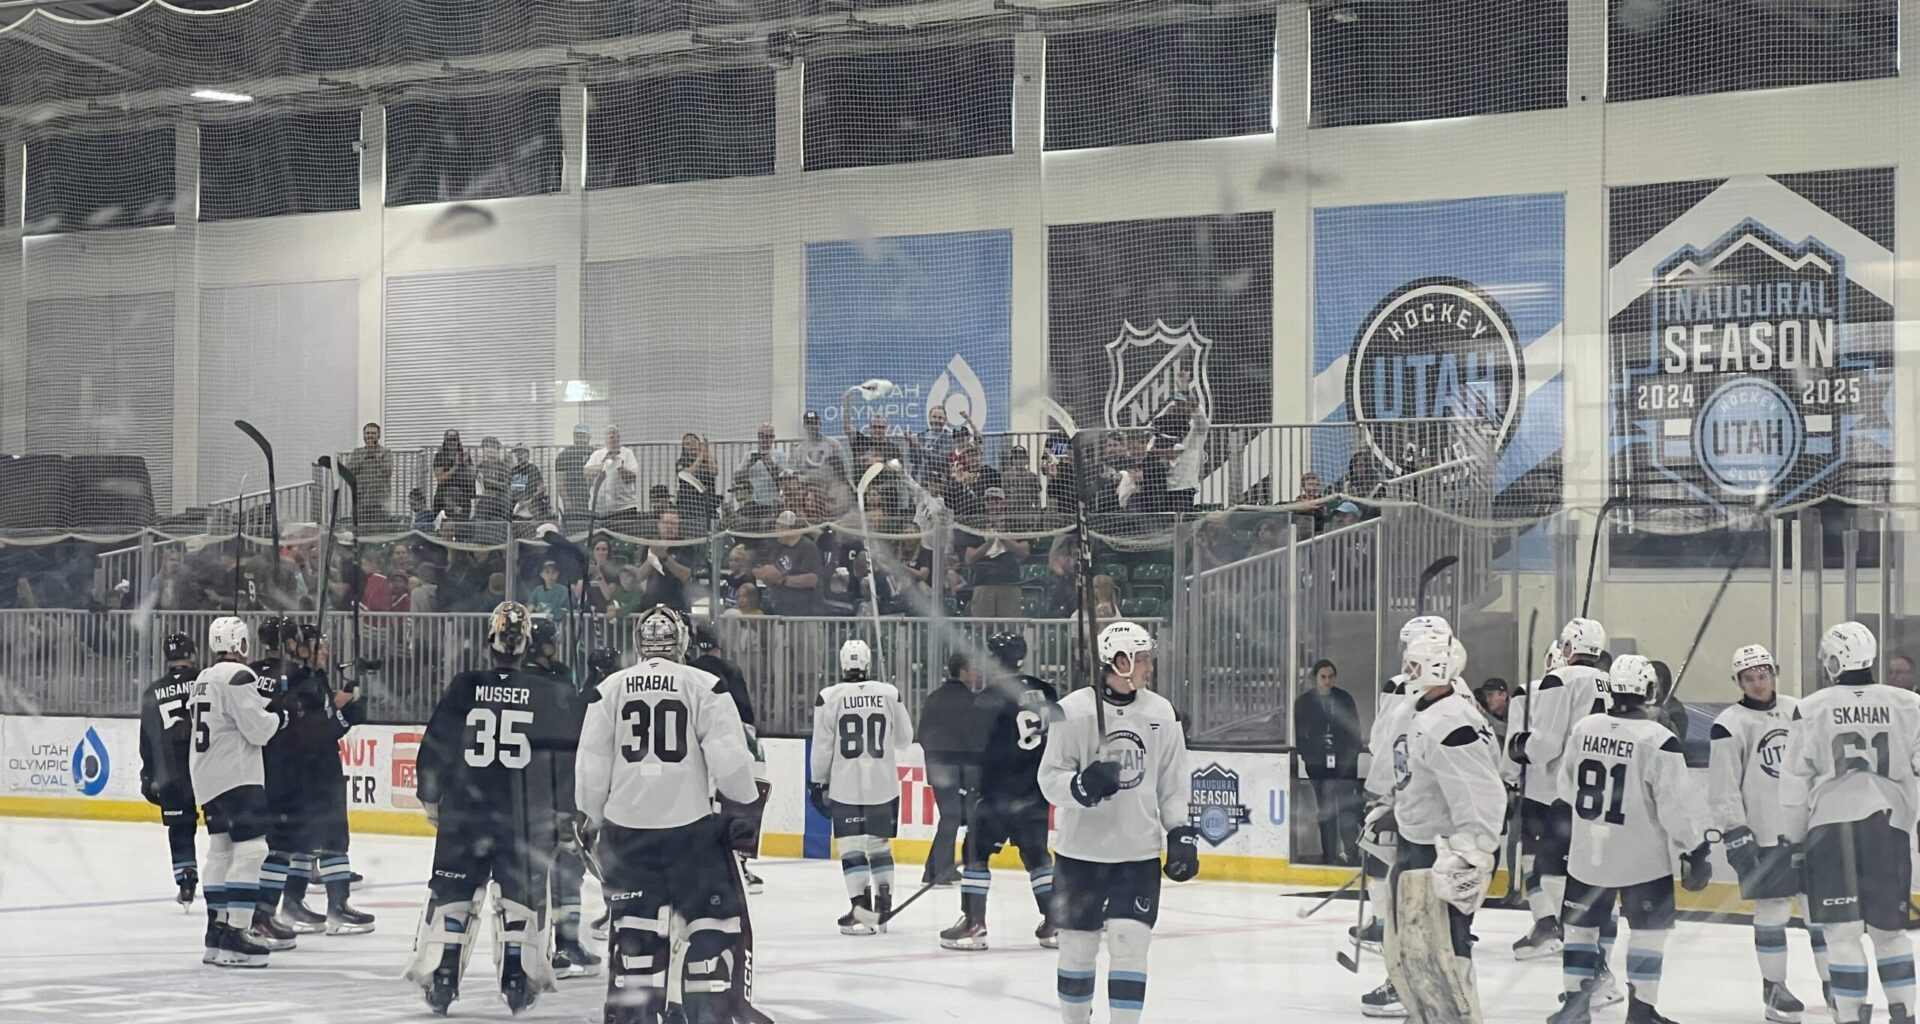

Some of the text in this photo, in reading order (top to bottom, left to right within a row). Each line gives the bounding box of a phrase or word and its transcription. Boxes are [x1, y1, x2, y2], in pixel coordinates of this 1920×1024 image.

[1664, 280, 1833, 321] INAUGURAL
[1387, 302, 1487, 342] HOCKEY
[1664, 319, 1834, 374] SEASON
[1373, 348, 1497, 422] UTAH
[1638, 384, 1695, 410] 2024
[1802, 377, 1860, 405] 2025
[1712, 418, 1783, 457] UTAH
[475, 685, 530, 705] MUSSER
[626, 675, 678, 694] HRABAL
[159, 699, 185, 730] 5
[843, 695, 884, 710] LUDTKE
[1833, 707, 1890, 725] SKAHAN
[190, 701, 212, 753] 5
[464, 708, 535, 769] 35
[621, 699, 688, 763] 30
[838, 712, 887, 760] 80
[31, 744, 69, 757] UTAH
[1582, 735, 1634, 758] HARMER
[1762, 744, 1787, 766] UT
[1831, 731, 1890, 780] 61
[9, 758, 69, 772] OLYMPIC
[30, 774, 68, 787] OVAL
[1575, 758, 1627, 826] 81
[1193, 790, 1237, 806] SEASON
[434, 868, 466, 880] CCM
[611, 890, 643, 901] CCM
[743, 949, 753, 1002] CCM
